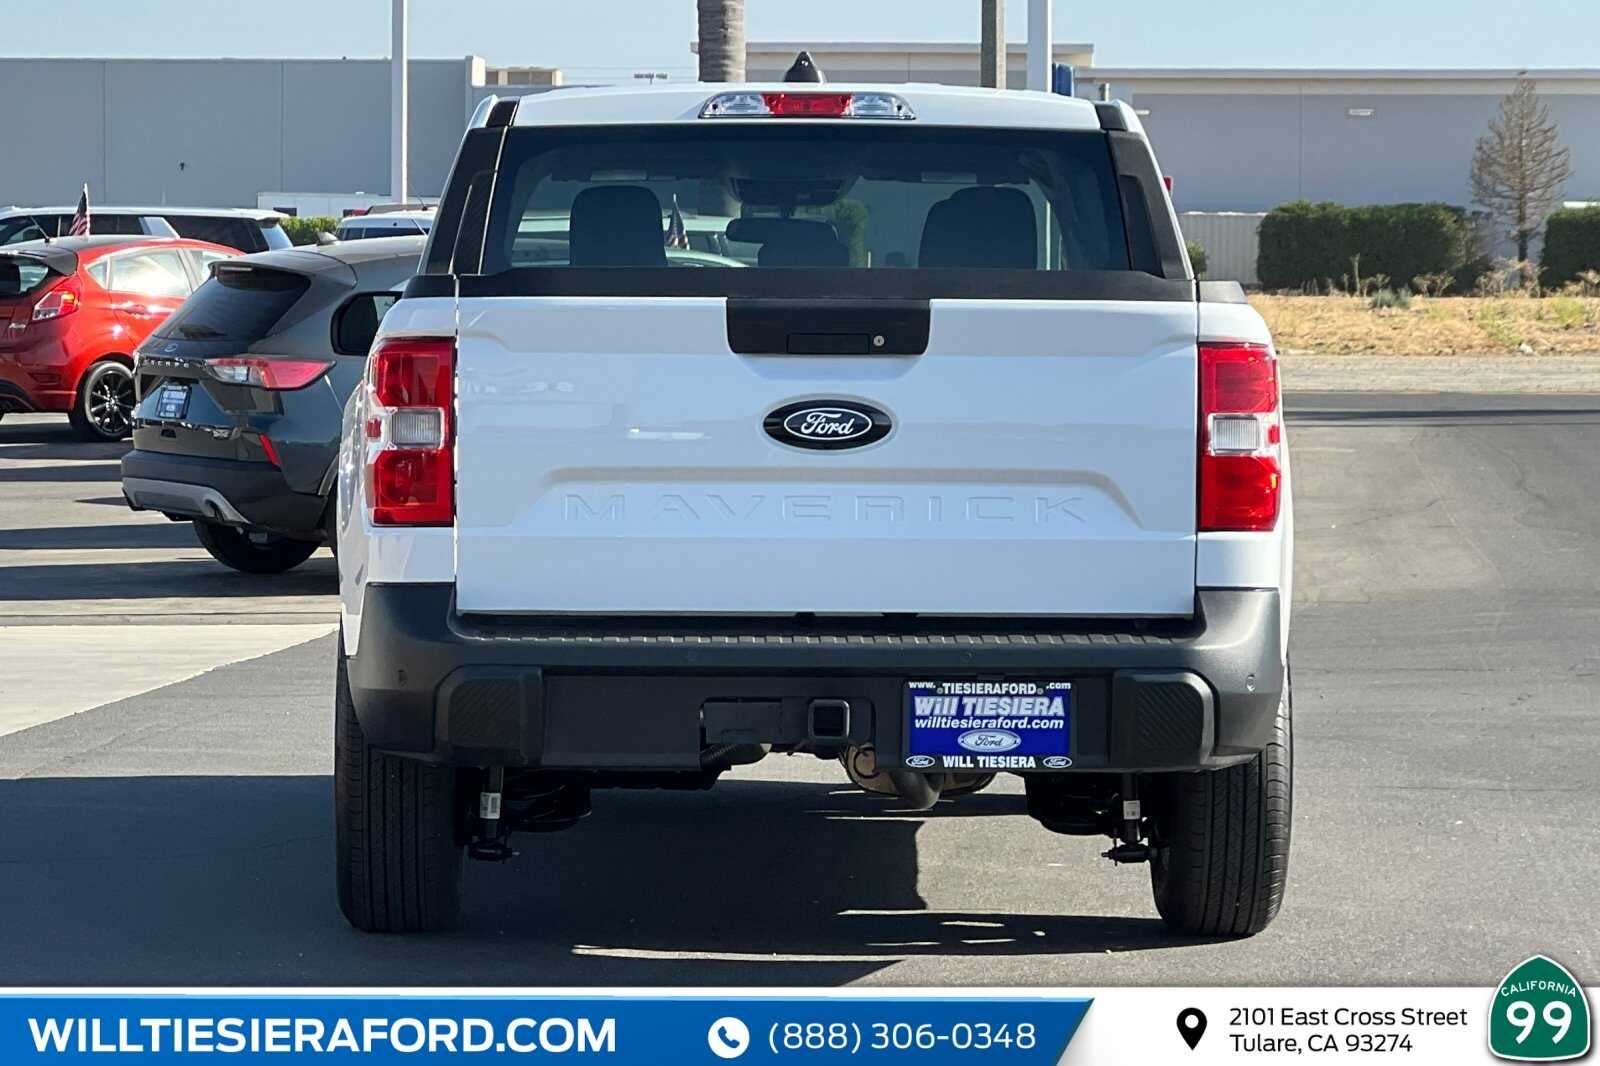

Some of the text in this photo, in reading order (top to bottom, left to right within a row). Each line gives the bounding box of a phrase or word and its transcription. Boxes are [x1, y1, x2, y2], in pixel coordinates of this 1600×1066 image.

[800, 412, 855, 436] Ford
[562, 493, 1090, 524] MAVERICK
[942, 683, 1037, 695] TIESIERAFORD
[962, 696, 1065, 717] TIESIERA
[915, 717, 1064, 729] willtiesieraford.com
[974, 735, 1003, 747] Ford
[943, 755, 1036, 768] WILL TIESIERA
